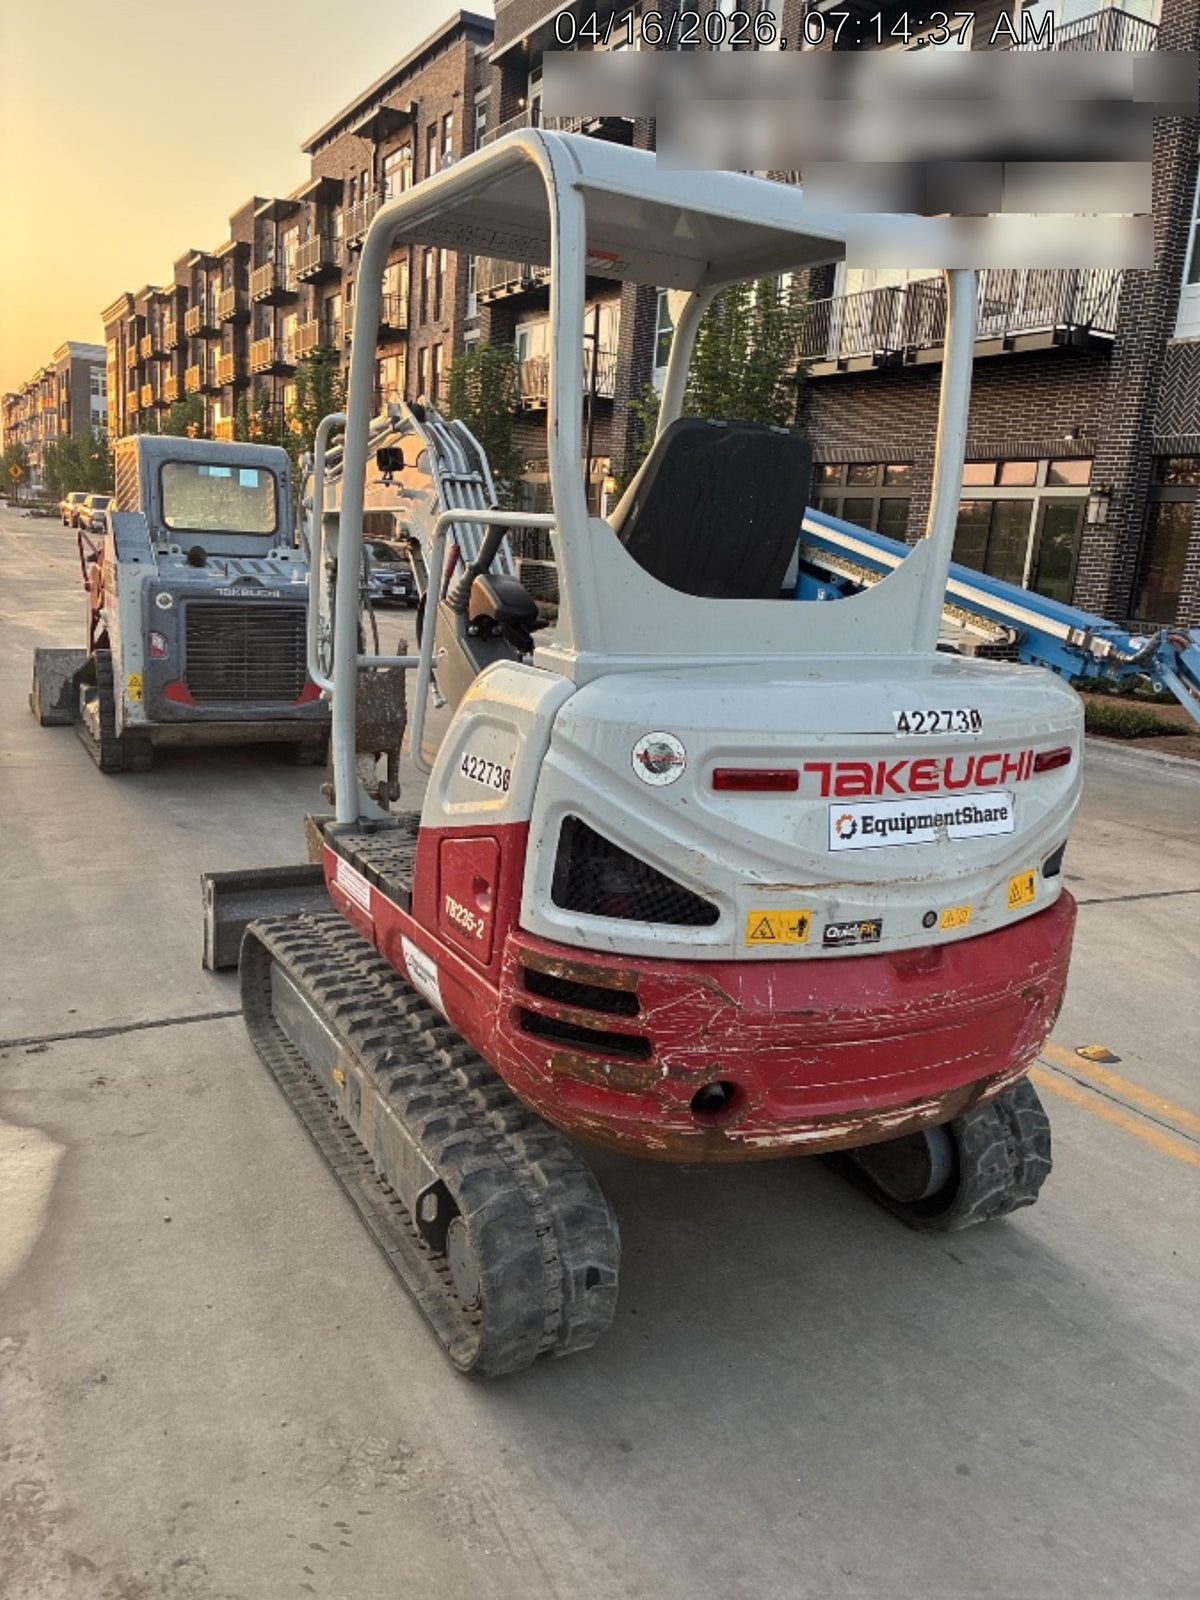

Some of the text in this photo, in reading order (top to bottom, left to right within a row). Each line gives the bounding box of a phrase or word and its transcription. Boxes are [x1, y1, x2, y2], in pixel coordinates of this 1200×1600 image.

[803, 749, 1034, 797] TAKEUCHI
[861, 805, 1008, 837] EquipmentShare
[445, 894, 484, 939] TB235-2
